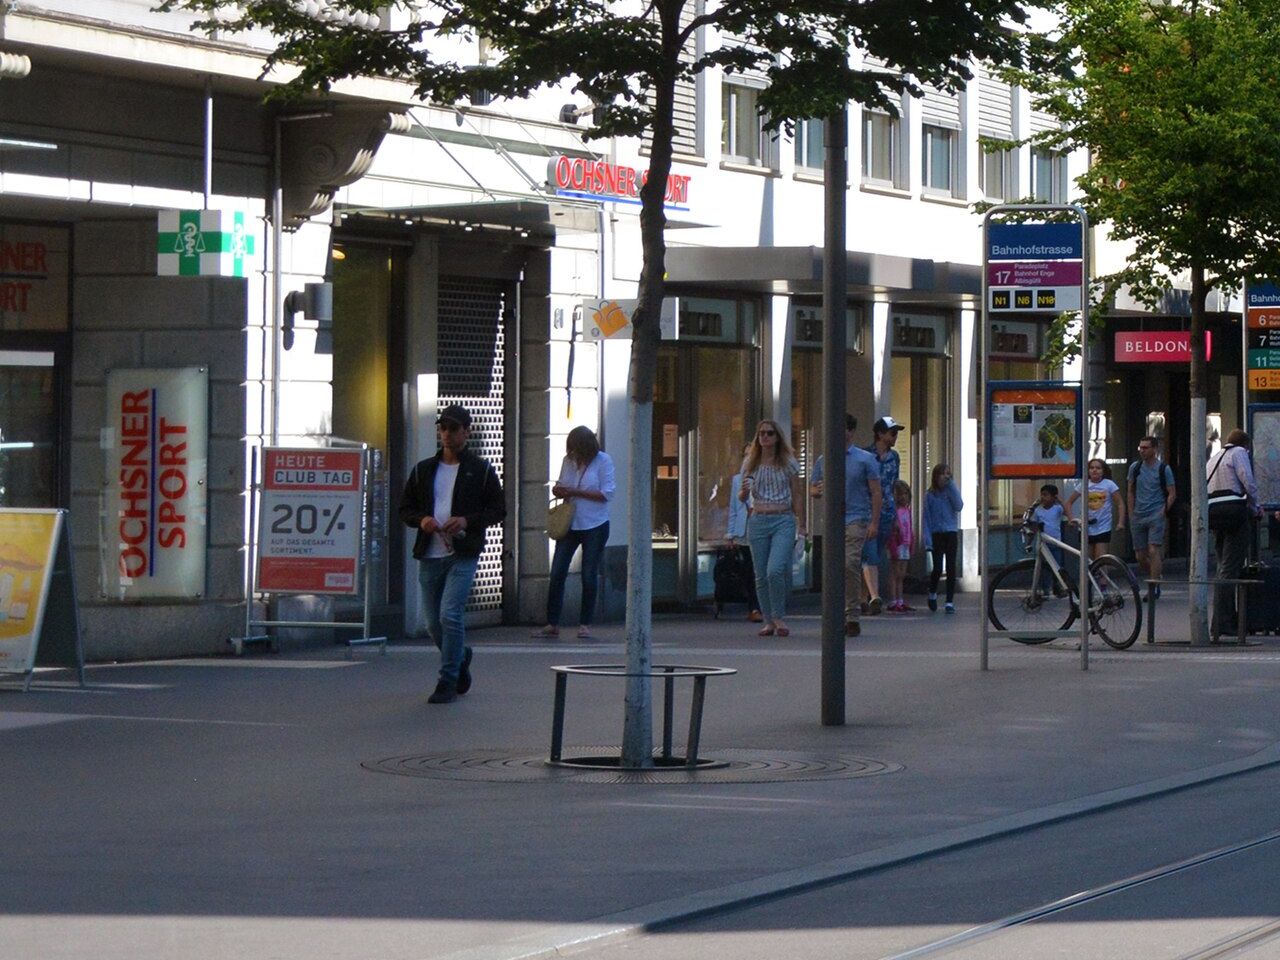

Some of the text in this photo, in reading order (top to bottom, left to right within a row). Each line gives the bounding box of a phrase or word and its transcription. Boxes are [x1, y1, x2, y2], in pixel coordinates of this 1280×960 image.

[555, 155, 636, 197] OCHSNER
[991, 245, 1073, 255] Bahnhofstrasse
[995, 271, 1011, 284] 17
[994, 297, 1006, 305] N1
[1258, 314, 1267, 326] 6
[1125, 341, 1192, 352] BELDON
[1259, 335, 1267, 347] 7
[1256, 356, 1267, 367] 11
[1254, 376, 1268, 388] 13
[275, 456, 325, 468] HEUTE
[119, 389, 149, 578] OCHSNER
[159, 416, 187, 549] SPORT
[275, 471, 351, 484] CLUB TAG
[271, 503, 346, 537] 20%
